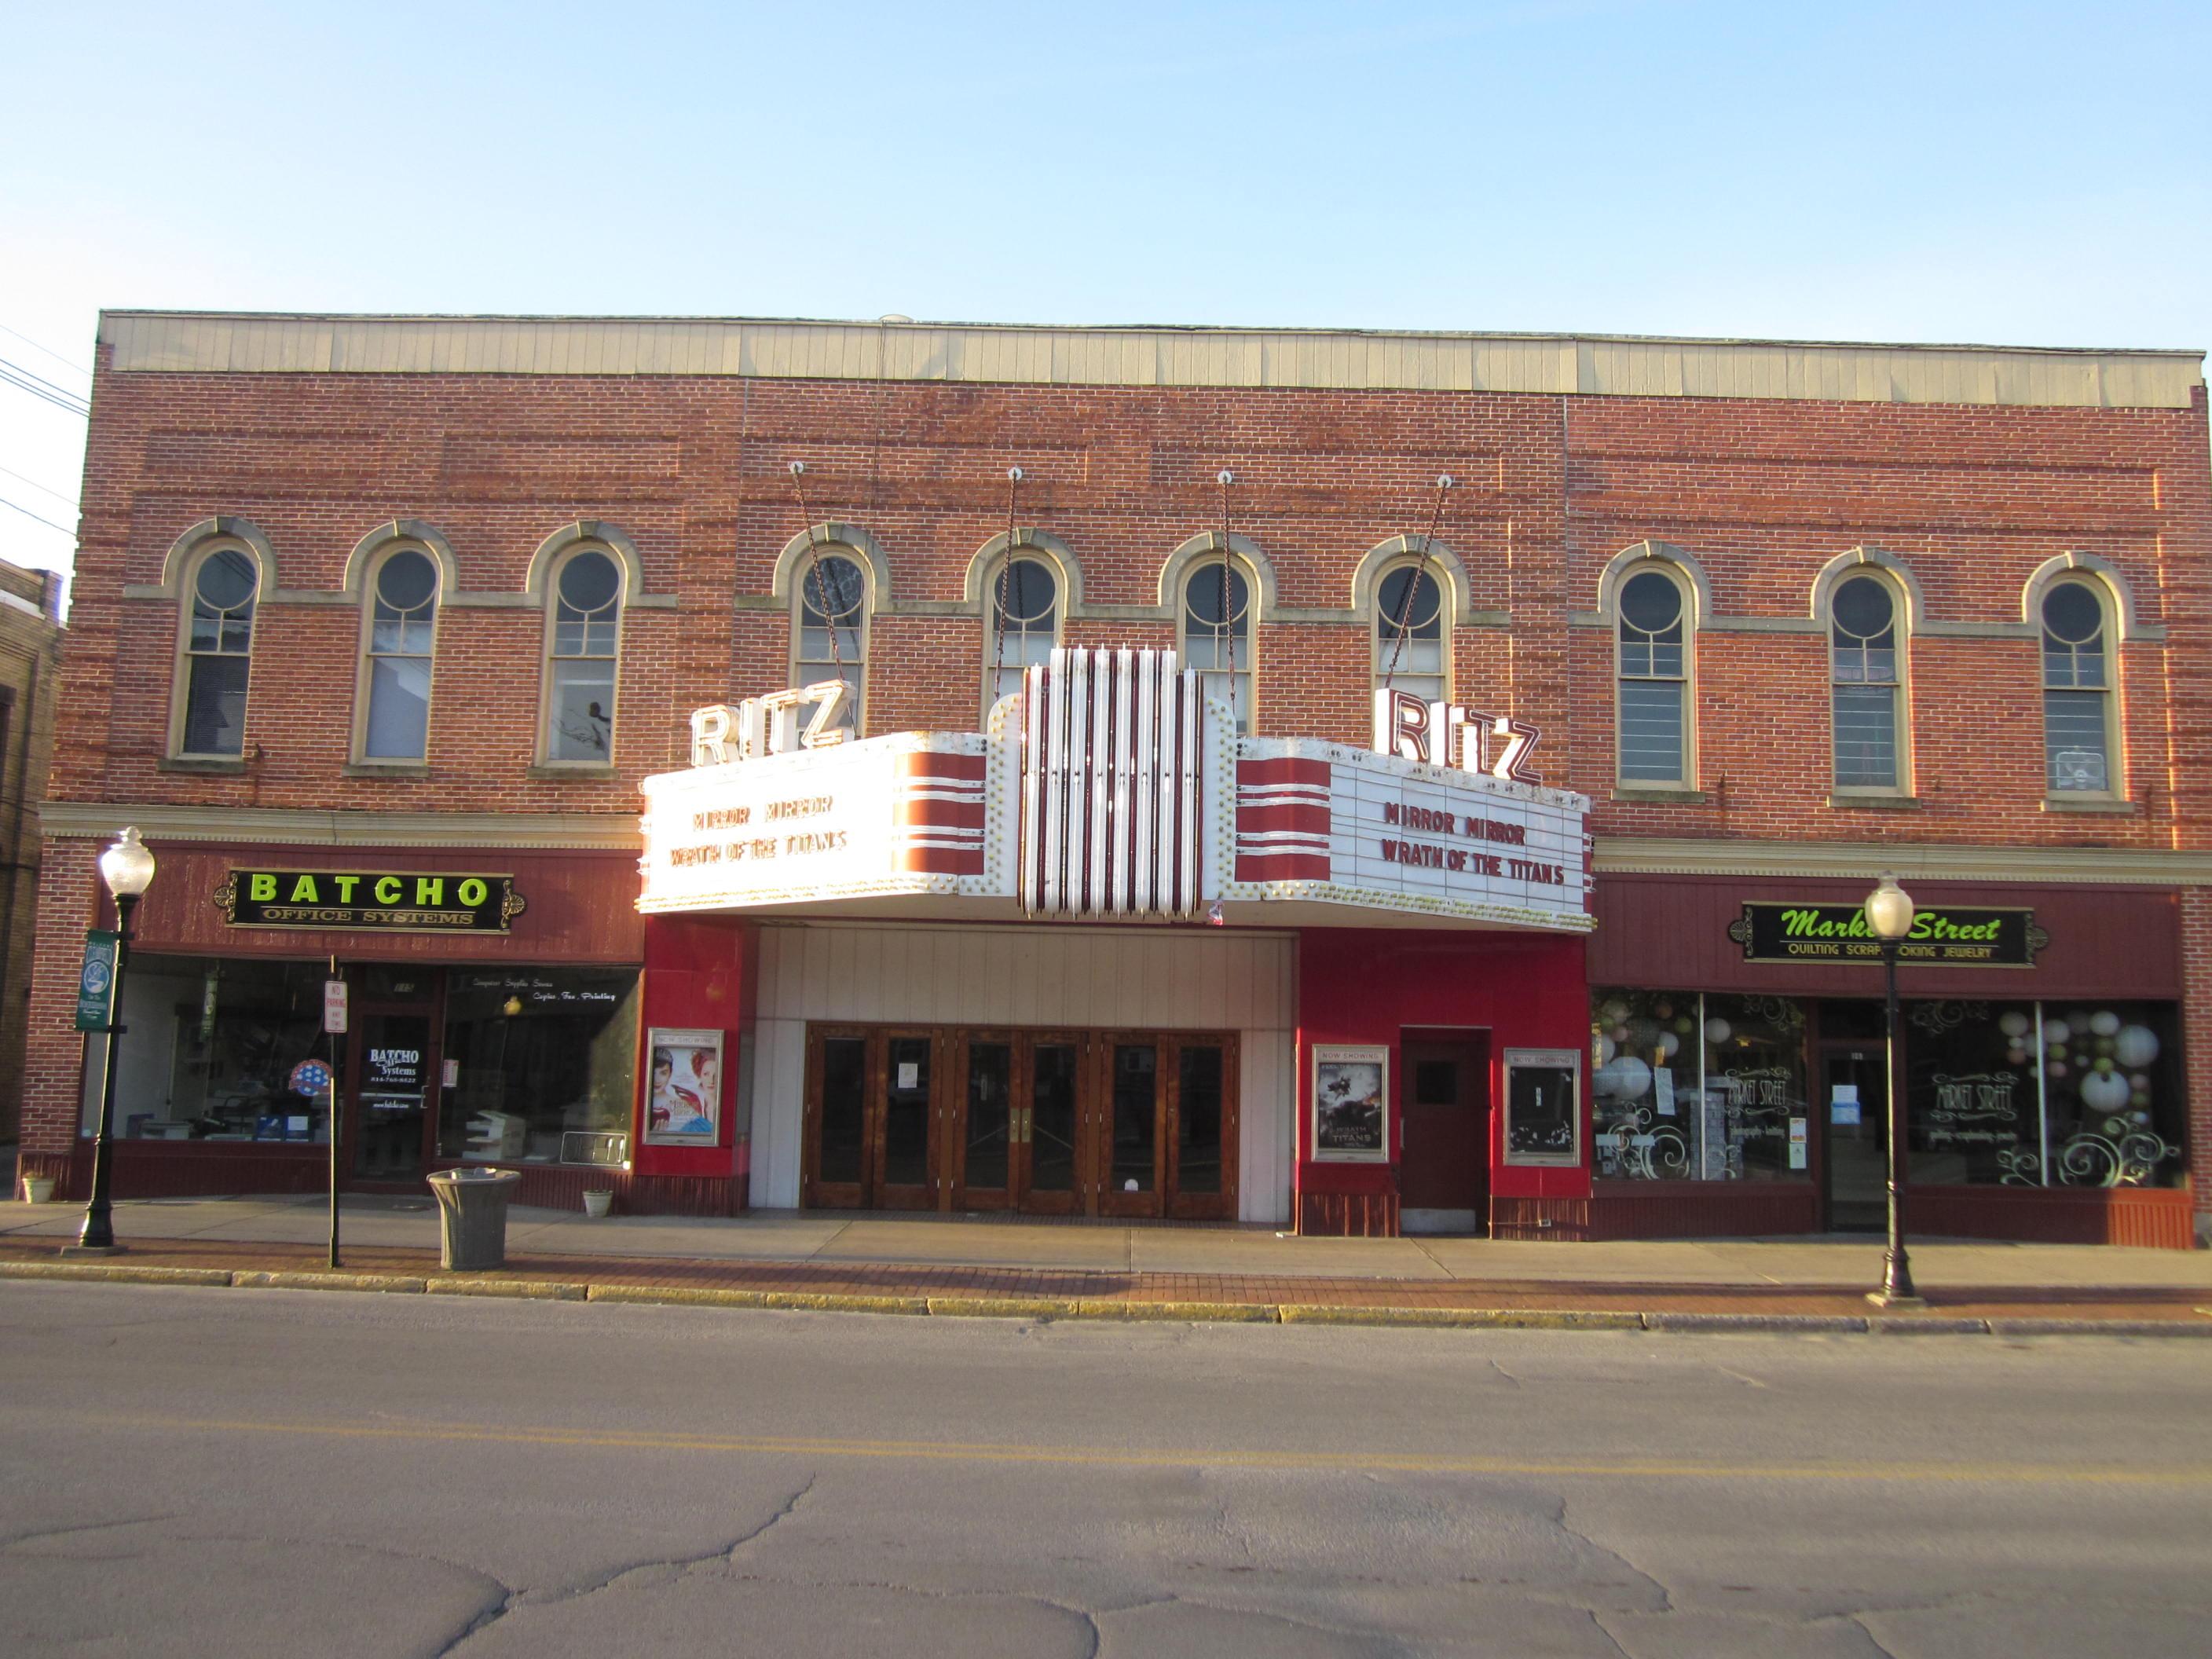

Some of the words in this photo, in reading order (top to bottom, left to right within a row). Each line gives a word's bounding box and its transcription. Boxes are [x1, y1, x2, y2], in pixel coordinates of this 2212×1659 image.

[690, 679, 845, 767] RITZ
[1375, 688, 1544, 786] RITZ
[693, 806, 751, 831] MIRROR
[764, 794, 833, 822] MIRROR
[1385, 802, 1455, 834] MIRROR
[1467, 817, 1525, 846] MIRROR
[670, 844, 722, 867] WRATH
[726, 840, 745, 862] OF
[747, 837, 777, 859] THE
[786, 830, 848, 855] TITANS
[1382, 839, 1443, 869] WRATH
[1447, 849, 1467, 872] OF
[1471, 853, 1502, 877] THE
[1507, 859, 1565, 885] TITANS
[251, 873, 488, 906] BATCHO
[262, 908, 353, 922] OFFICE
[363, 910, 474, 925] SYSTEMS
[1781, 909, 1876, 938] Mark
[1908, 912, 2001, 941] Street
[1787, 943, 1840, 956] QUILTING
[1847, 944, 1936, 958] SCRAPOKING
[1943, 947, 1992, 958] JEWELRY
[580, 993, 617, 1002] Printing
[370, 1049, 419, 1064] BATCHO
[381, 1065, 417, 1077] Systems
[1760, 1080, 1787, 1106] STREET
[1331, 1133, 1372, 1143] TITANS
